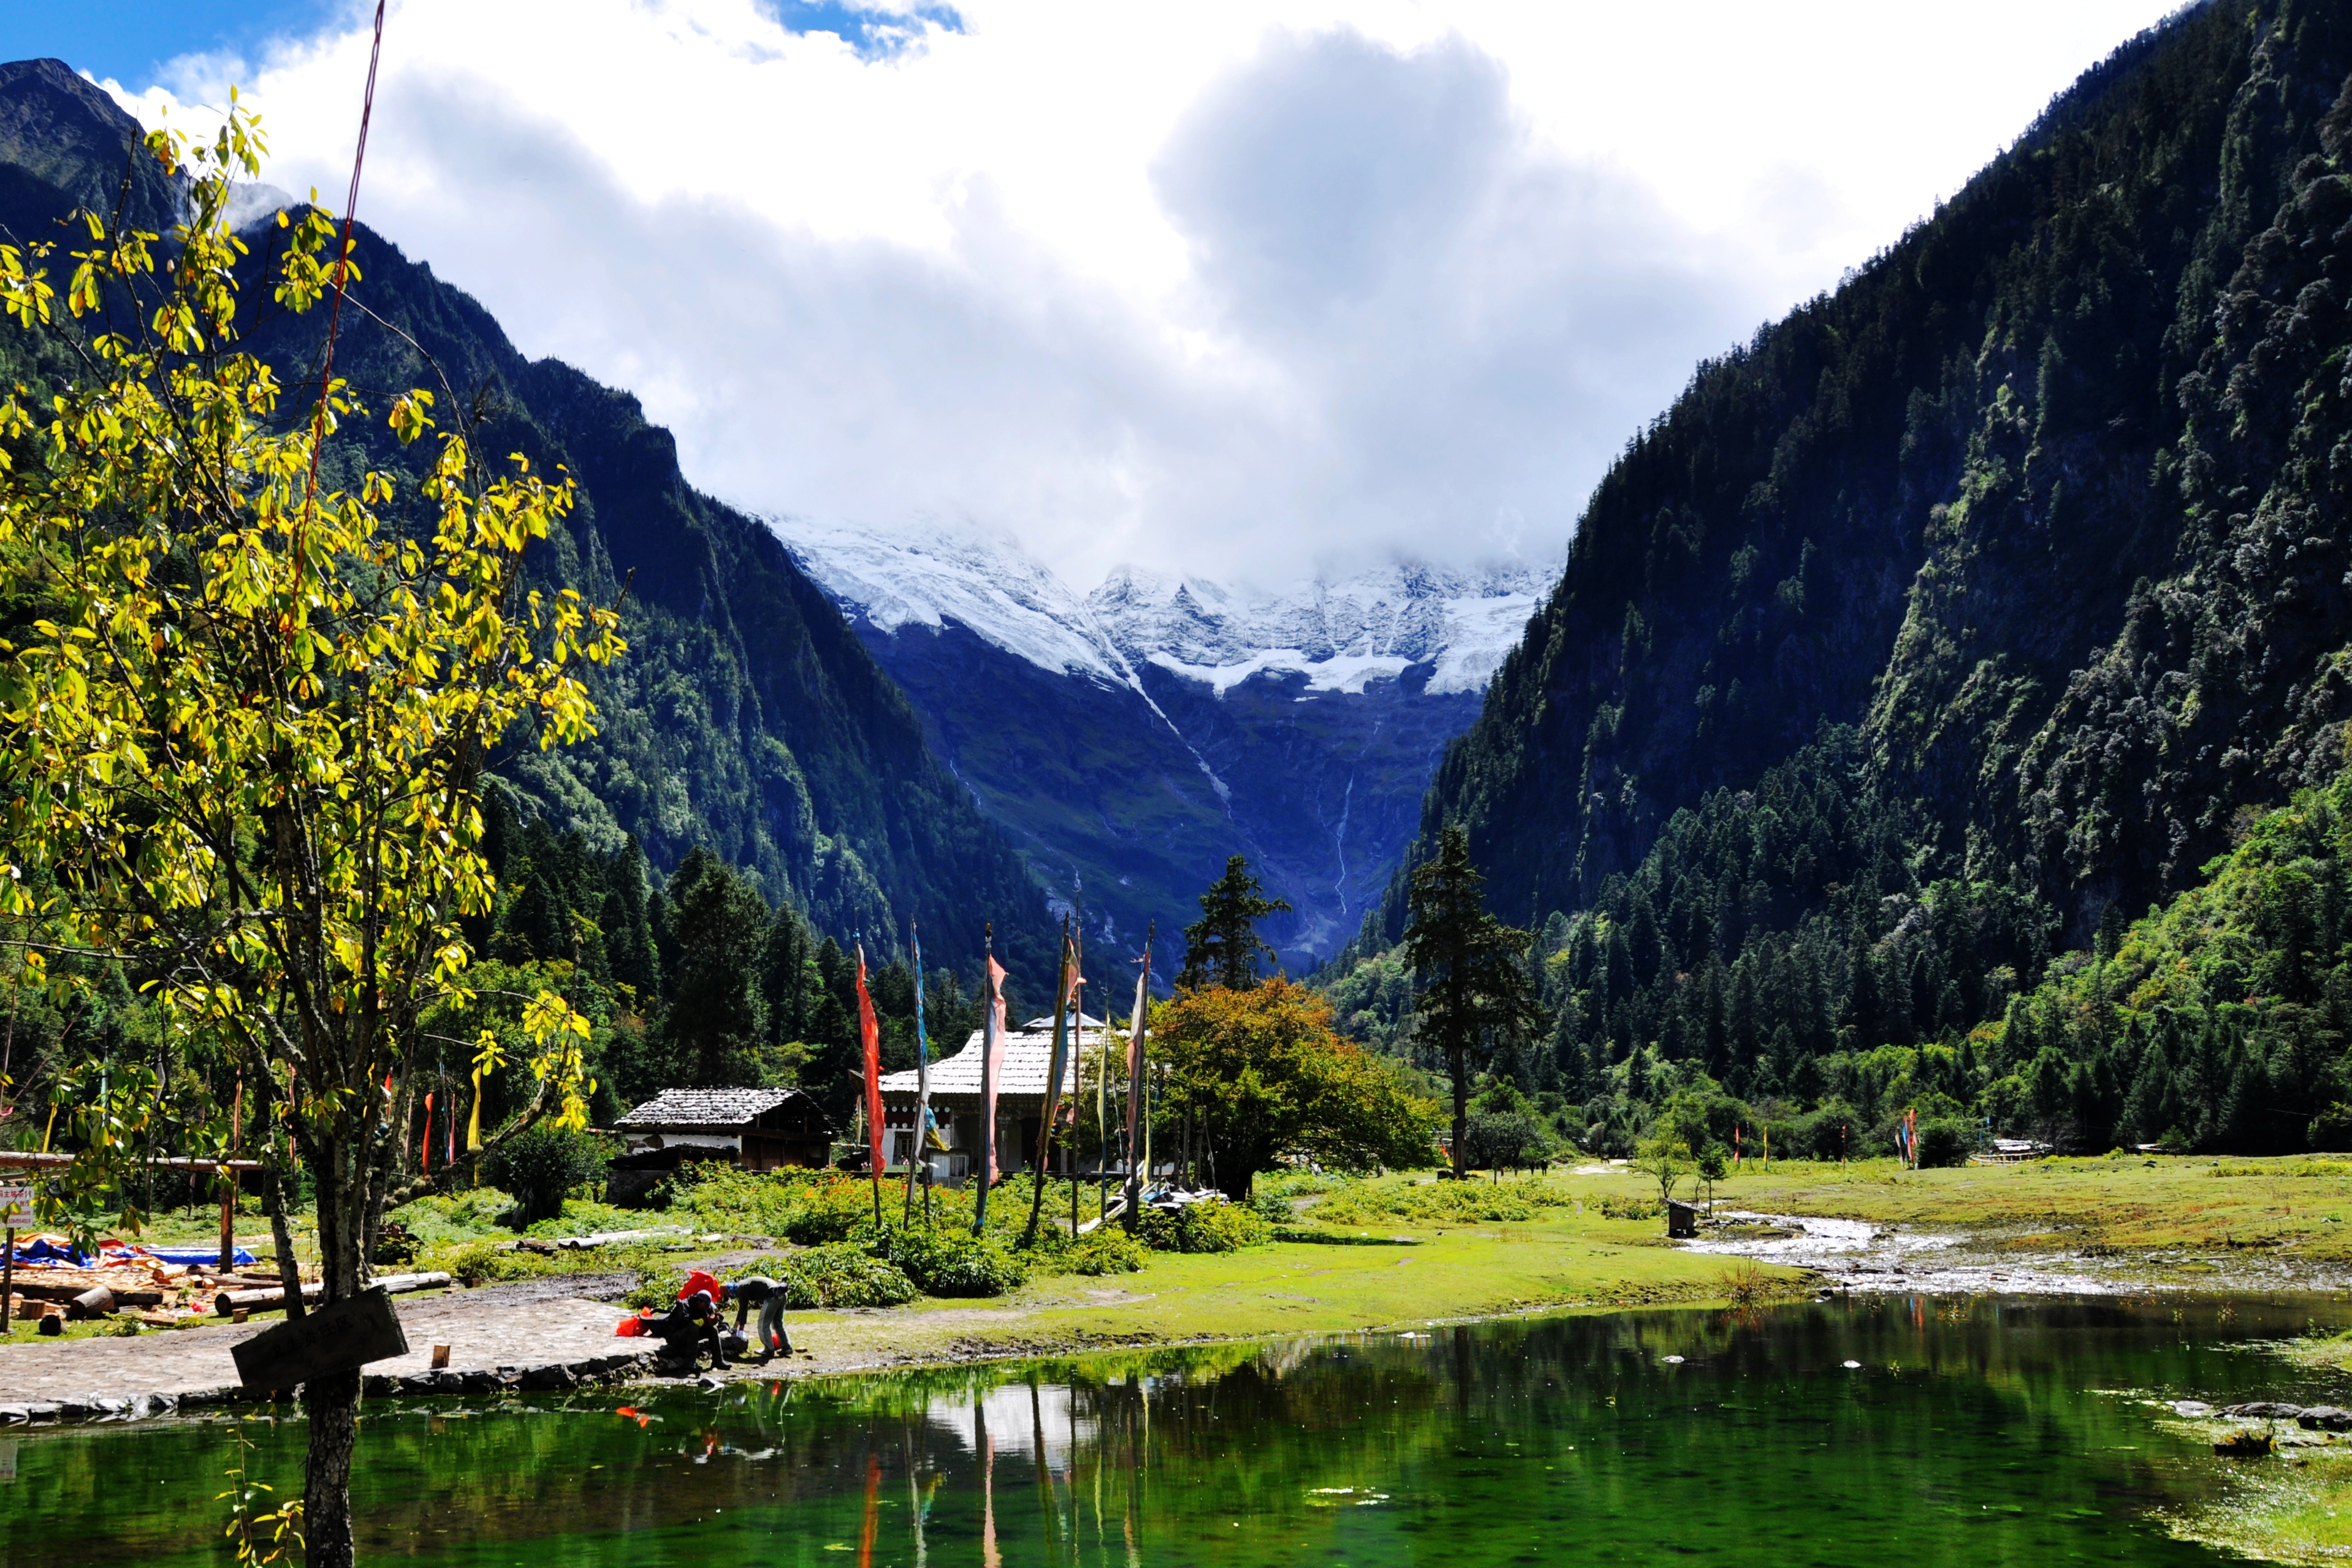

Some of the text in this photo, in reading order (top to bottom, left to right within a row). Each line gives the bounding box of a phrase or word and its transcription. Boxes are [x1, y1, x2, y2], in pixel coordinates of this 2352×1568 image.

[271, 1314, 354, 1360] 卫生责任区
